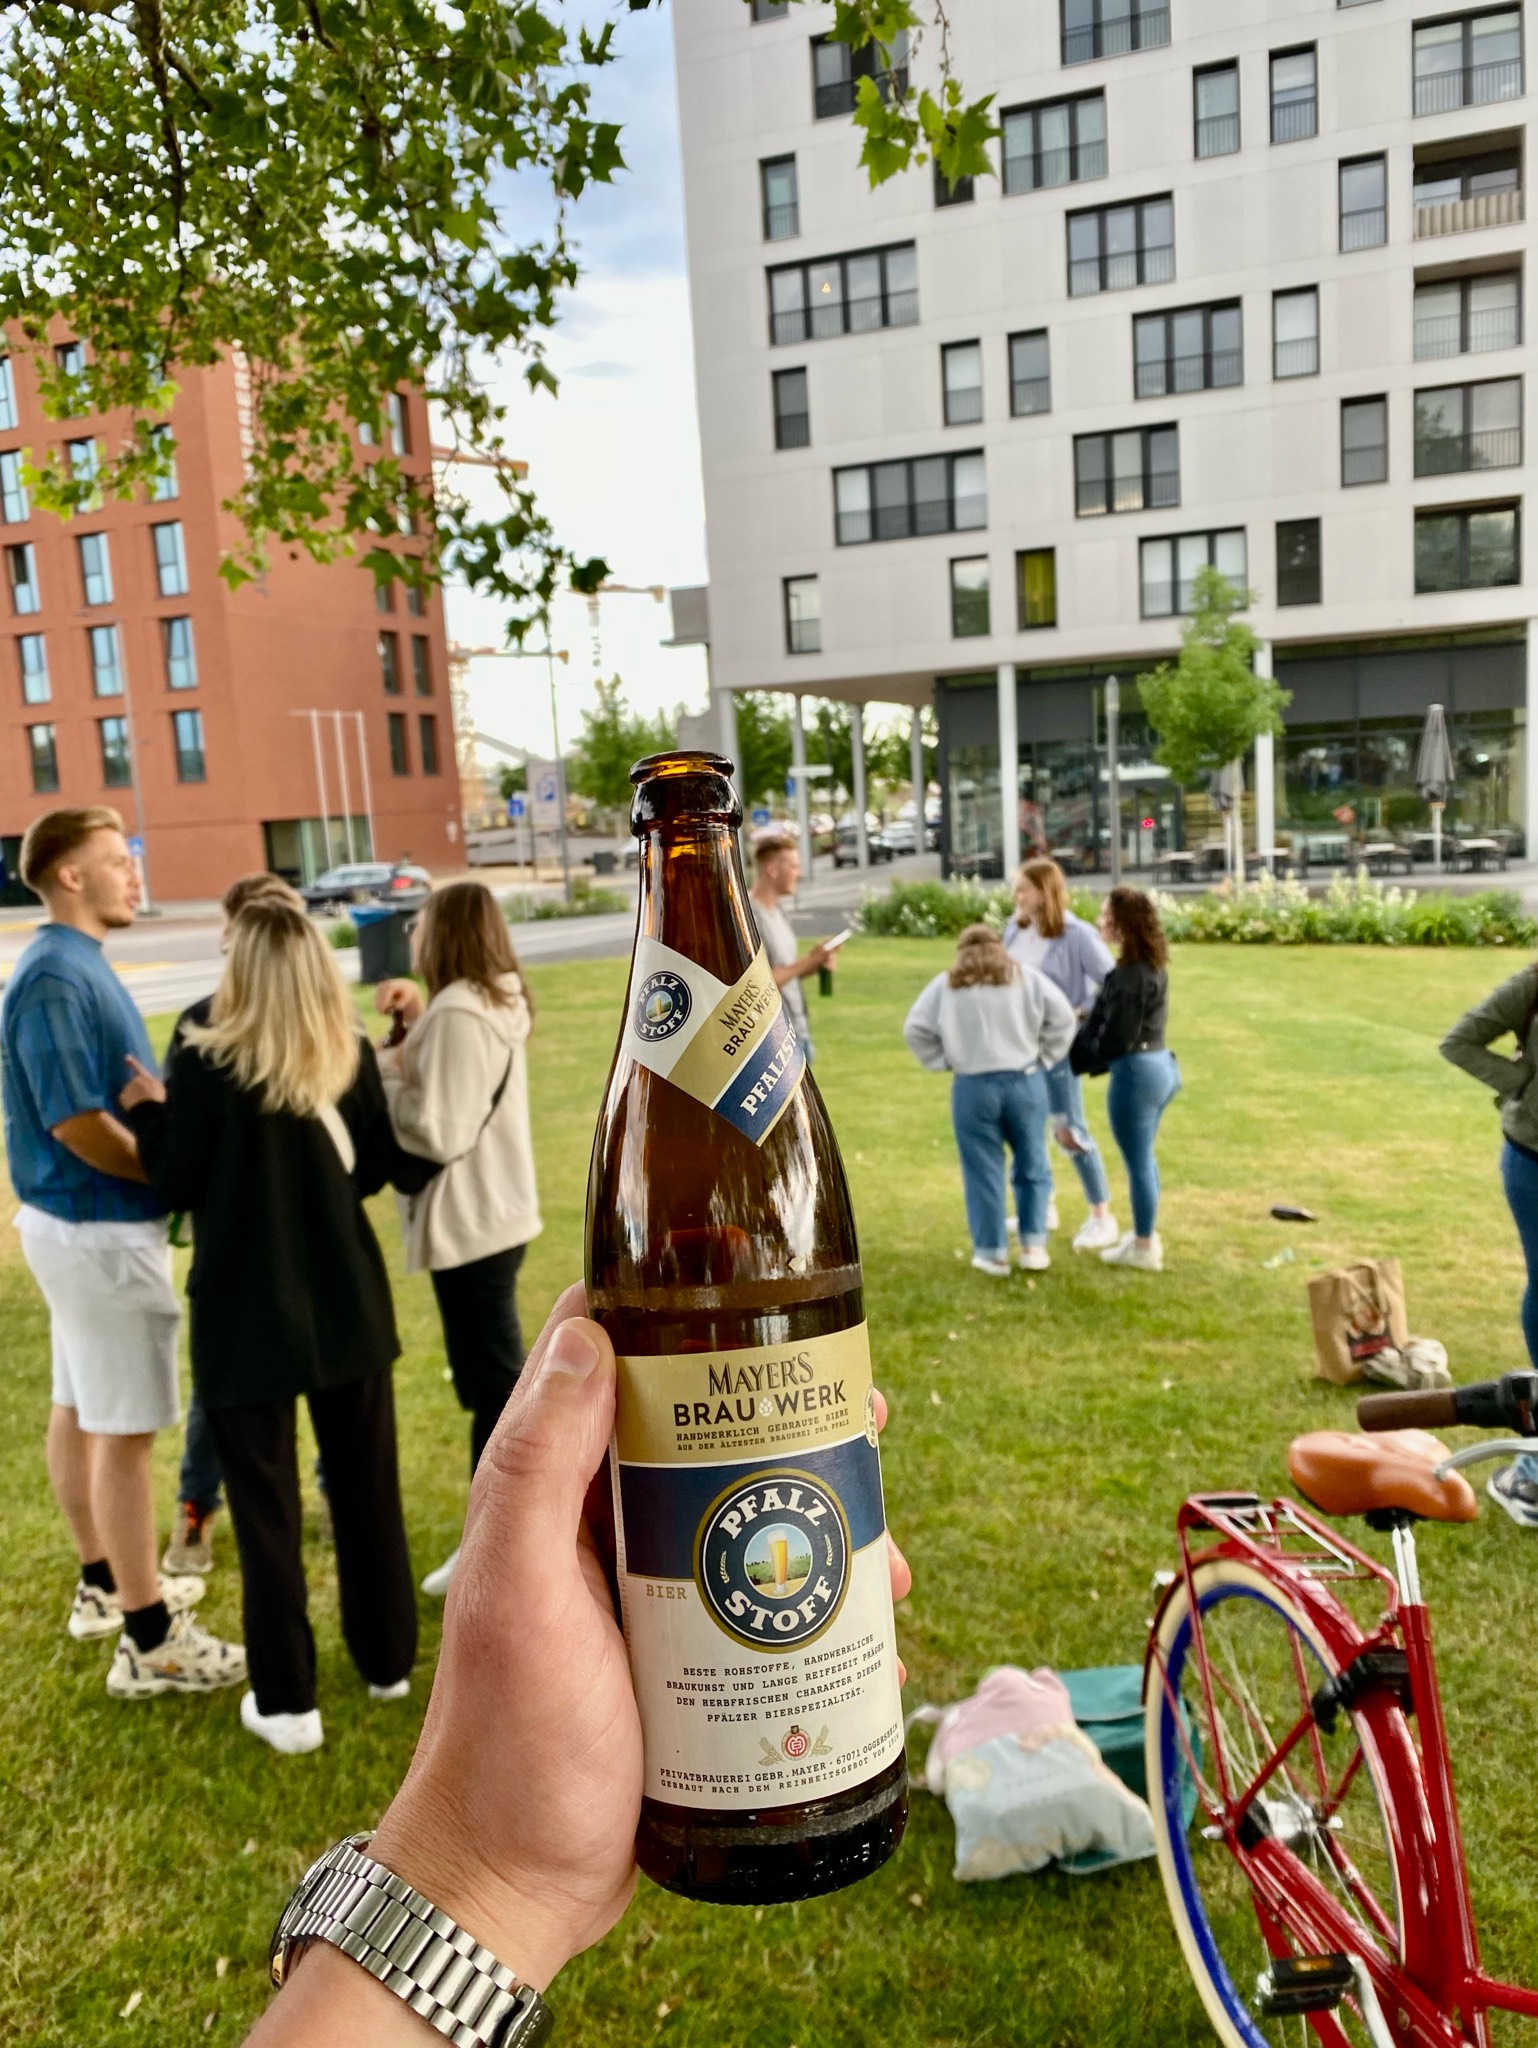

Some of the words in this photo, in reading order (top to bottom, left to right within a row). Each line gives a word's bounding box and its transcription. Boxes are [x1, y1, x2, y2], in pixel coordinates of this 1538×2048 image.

[639, 976, 679, 1004] PFALZ
[719, 979, 760, 1031] MAYER'S
[640, 1009, 683, 1036] STOFF
[722, 1016, 755, 1056] BRAU
[753, 982, 776, 1015] WERK
[708, 1351, 814, 1396] MAYER'S
[673, 1397, 755, 1427] BRAU
[773, 1380, 847, 1417] WERK
[676, 1427, 760, 1441] HANDWERKLICH
[767, 1416, 820, 1433] GEBRAUTE
[825, 1408, 849, 1421] BIERE
[677, 1443, 693, 1451] AUS
[698, 1442, 715, 1450] DER
[720, 1437, 766, 1449] ÄLTESTEN
[770, 1431, 811, 1442] BRAUEREI
[815, 1425, 829, 1435] DER
[719, 1487, 828, 1540] PFALZ
[646, 1584, 688, 1600] BIER
[724, 1575, 834, 1631] STOFF
[666, 1680, 725, 1692] BRAUKUNST
[733, 1682, 755, 1691] UND
[762, 1676, 798, 1689] LANGE
[805, 1658, 858, 1681] REIFEZEIT
[862, 1641, 885, 1662] PRÄGEN
[683, 1667, 717, 1677] BESTE
[724, 1662, 795, 1677] ROHSTOFFE,
[804, 1634, 874, 1666] HANDWERKLICHE
[676, 1696, 695, 1706] DEN
[702, 1693, 789, 1707] HERBFRISCHEN
[796, 1676, 853, 1699] CHARAKTER
[857, 1659, 882, 1680] DIESER
[707, 1712, 758, 1722] PFÄLZER
[765, 1687, 865, 1720] BIERSPEZIALITÄT.
[660, 1768, 750, 1783] PRIVATBRAUEREI
[836, 1749, 861, 1765] 67071
[661, 1779, 703, 1793] GEBRAUT
[748, 1784, 770, 1793] DEM
[779, 1757, 868, 1790] REINHEITSGEBOT
[873, 1746, 885, 1759] VON
